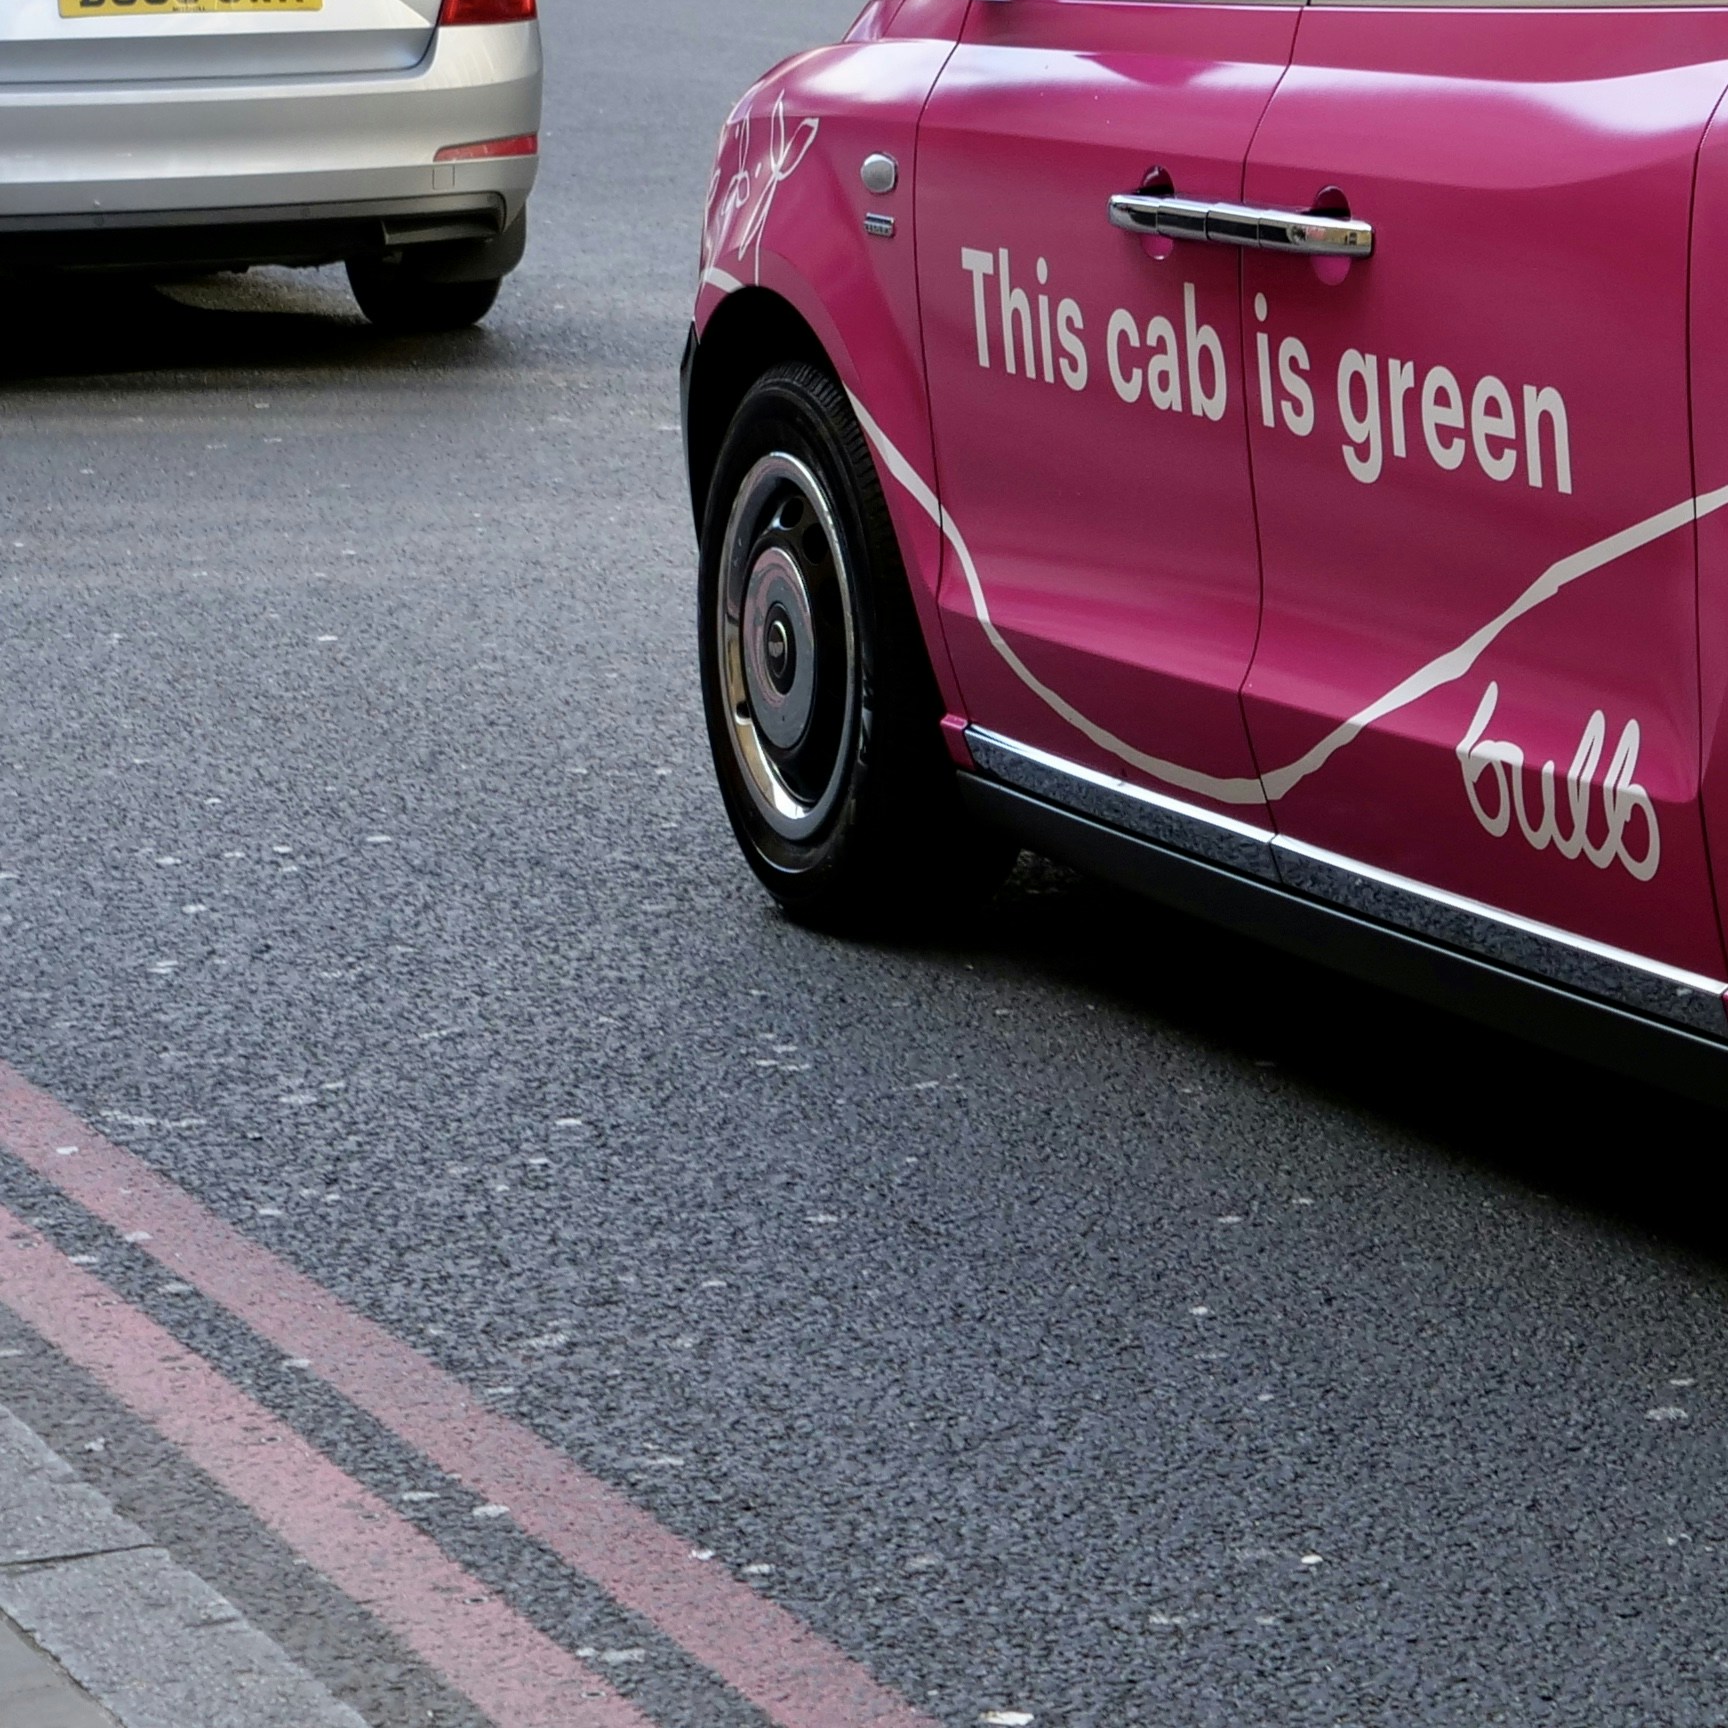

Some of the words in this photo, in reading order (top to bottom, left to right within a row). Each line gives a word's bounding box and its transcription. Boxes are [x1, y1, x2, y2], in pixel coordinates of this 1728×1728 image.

[961, 246, 1089, 392] This
[1106, 281, 1228, 423] cab
[1254, 291, 1314, 438] is
[1336, 347, 1573, 496] green
[1454, 680, 1662, 883] bulb
